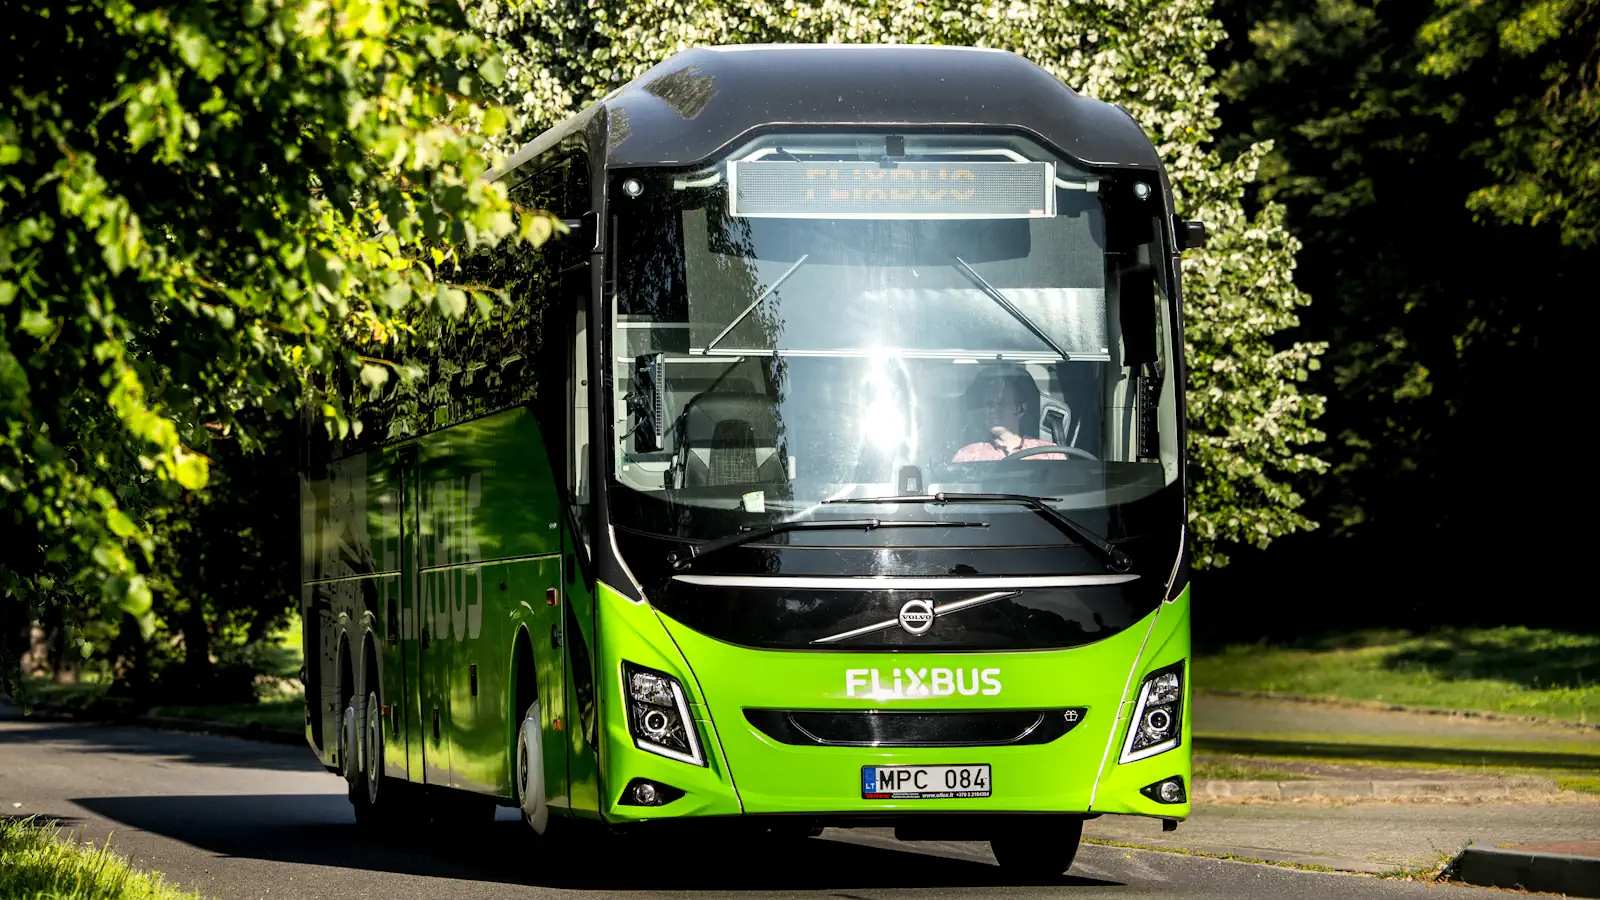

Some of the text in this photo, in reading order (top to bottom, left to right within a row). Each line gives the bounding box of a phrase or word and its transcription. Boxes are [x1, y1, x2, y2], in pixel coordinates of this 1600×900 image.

[865, 782, 875, 790] LT
[879, 768, 985, 790] MPC 084
